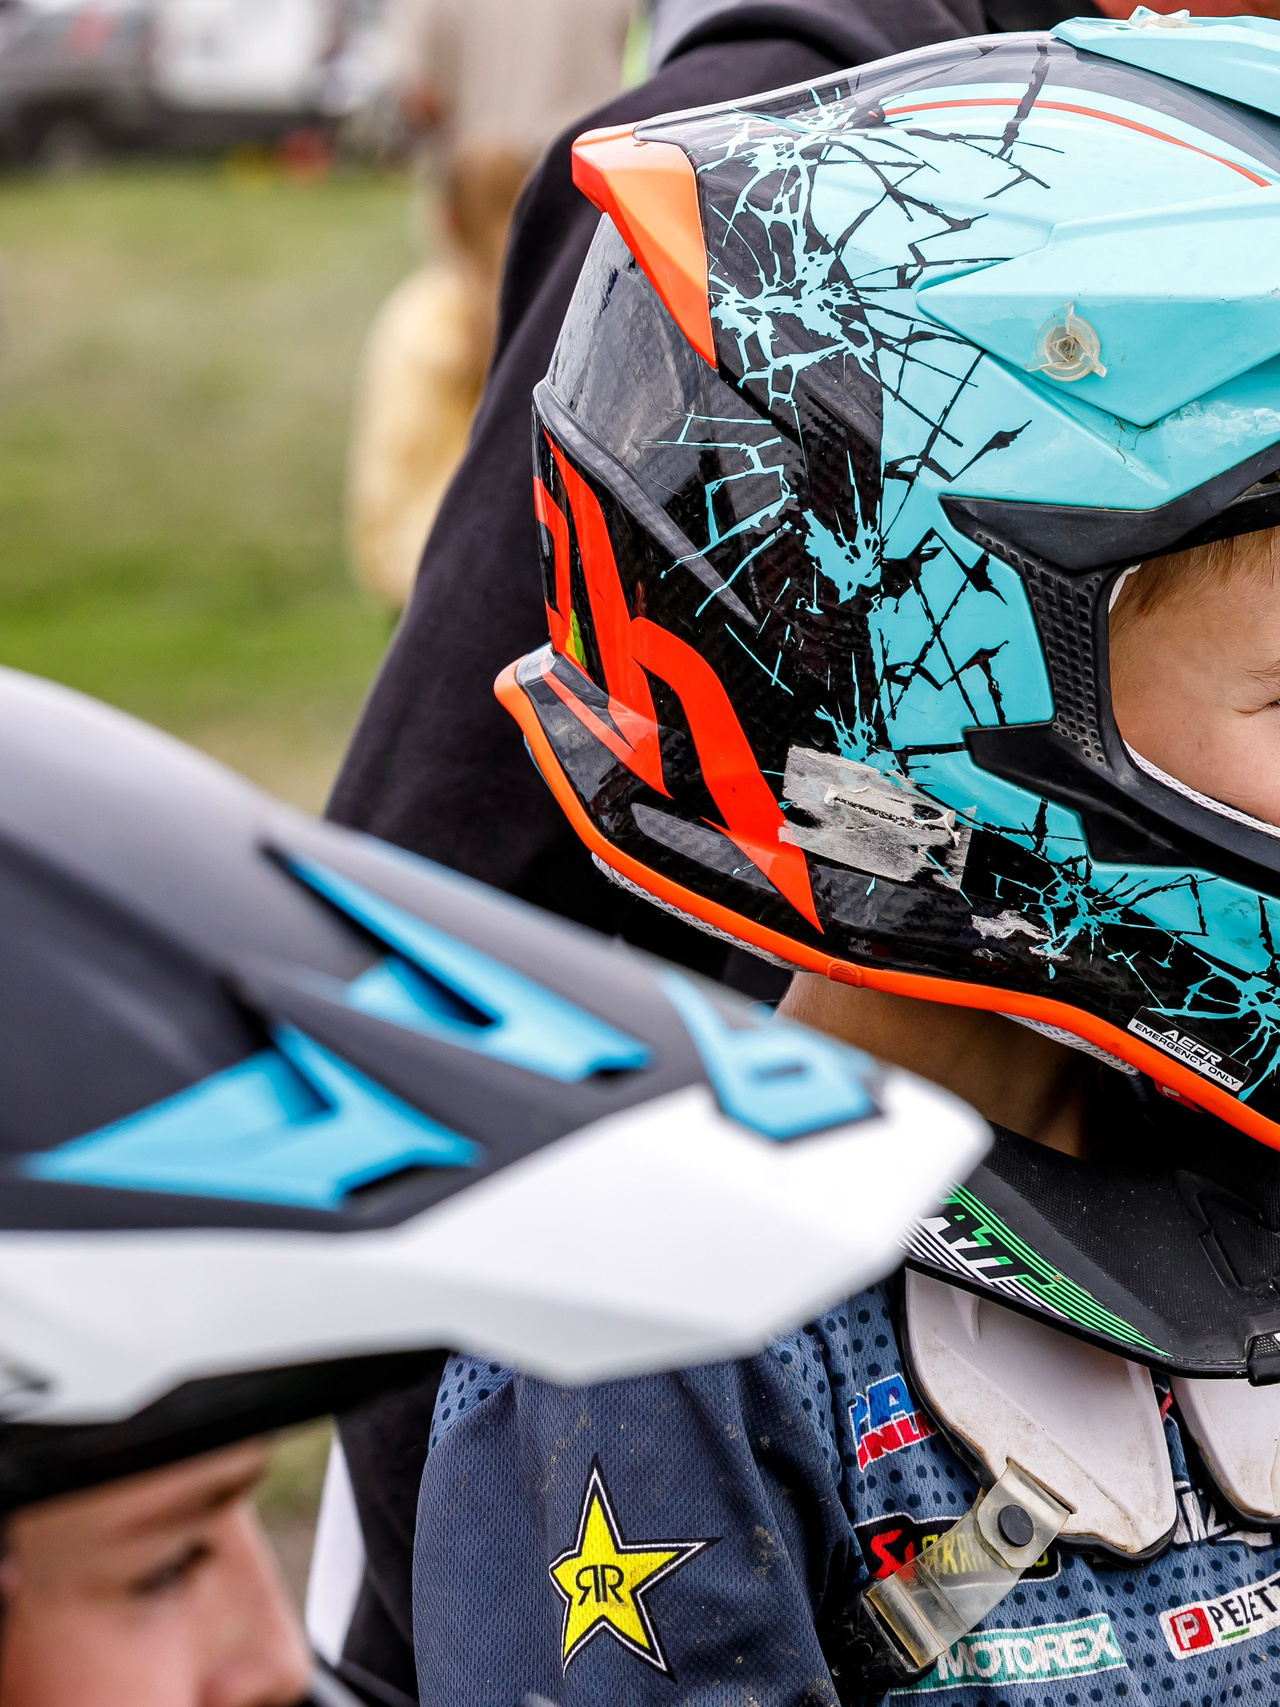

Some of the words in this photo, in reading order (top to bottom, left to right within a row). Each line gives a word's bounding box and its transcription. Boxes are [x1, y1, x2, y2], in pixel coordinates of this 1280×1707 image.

[1134, 1021, 1207, 1068] EMERGENCY
[1207, 1065, 1239, 1086] ONLY
[1161, 1029, 1223, 1066] AEFR
[936, 1622, 1122, 1681] MOTOREX
